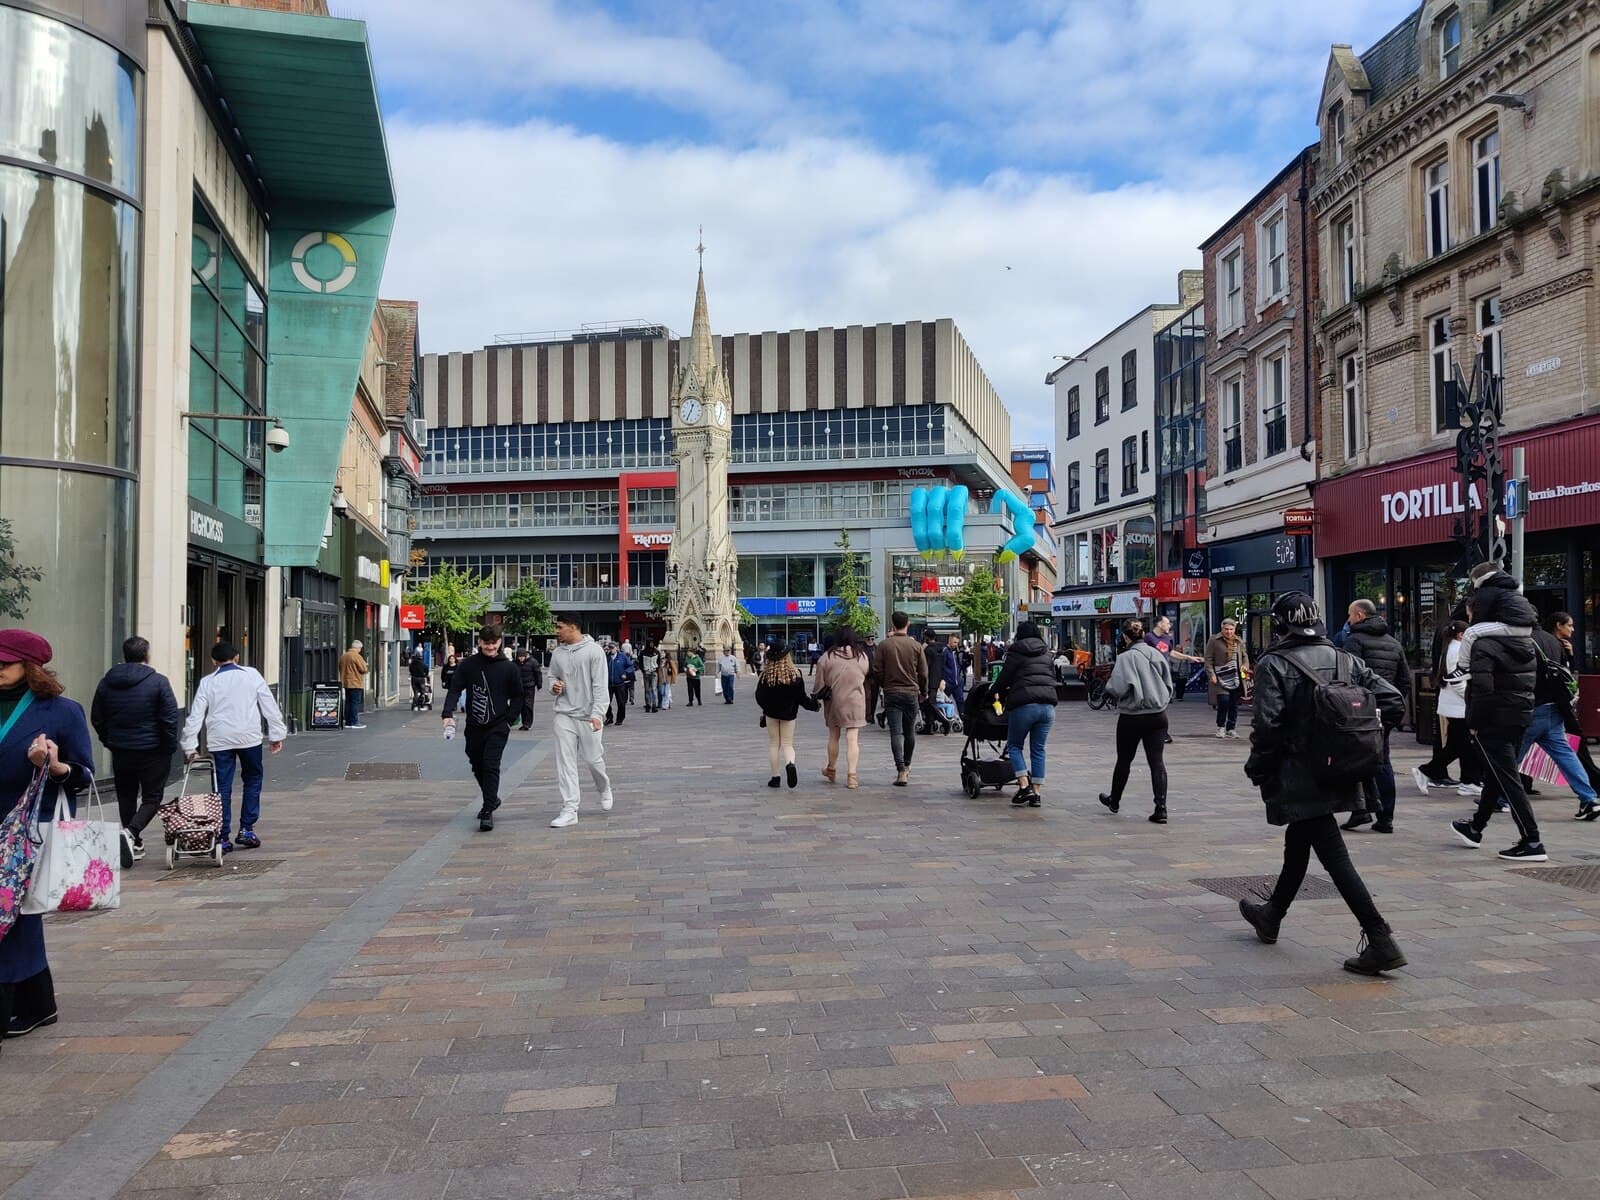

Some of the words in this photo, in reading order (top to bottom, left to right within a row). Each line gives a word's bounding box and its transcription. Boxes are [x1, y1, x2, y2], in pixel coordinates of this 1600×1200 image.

[1380, 480, 1482, 524] TORTILLA
[921, 575, 965, 593] METRO
[786, 600, 817, 611] METRO
[472, 683, 488, 723] NIKE
